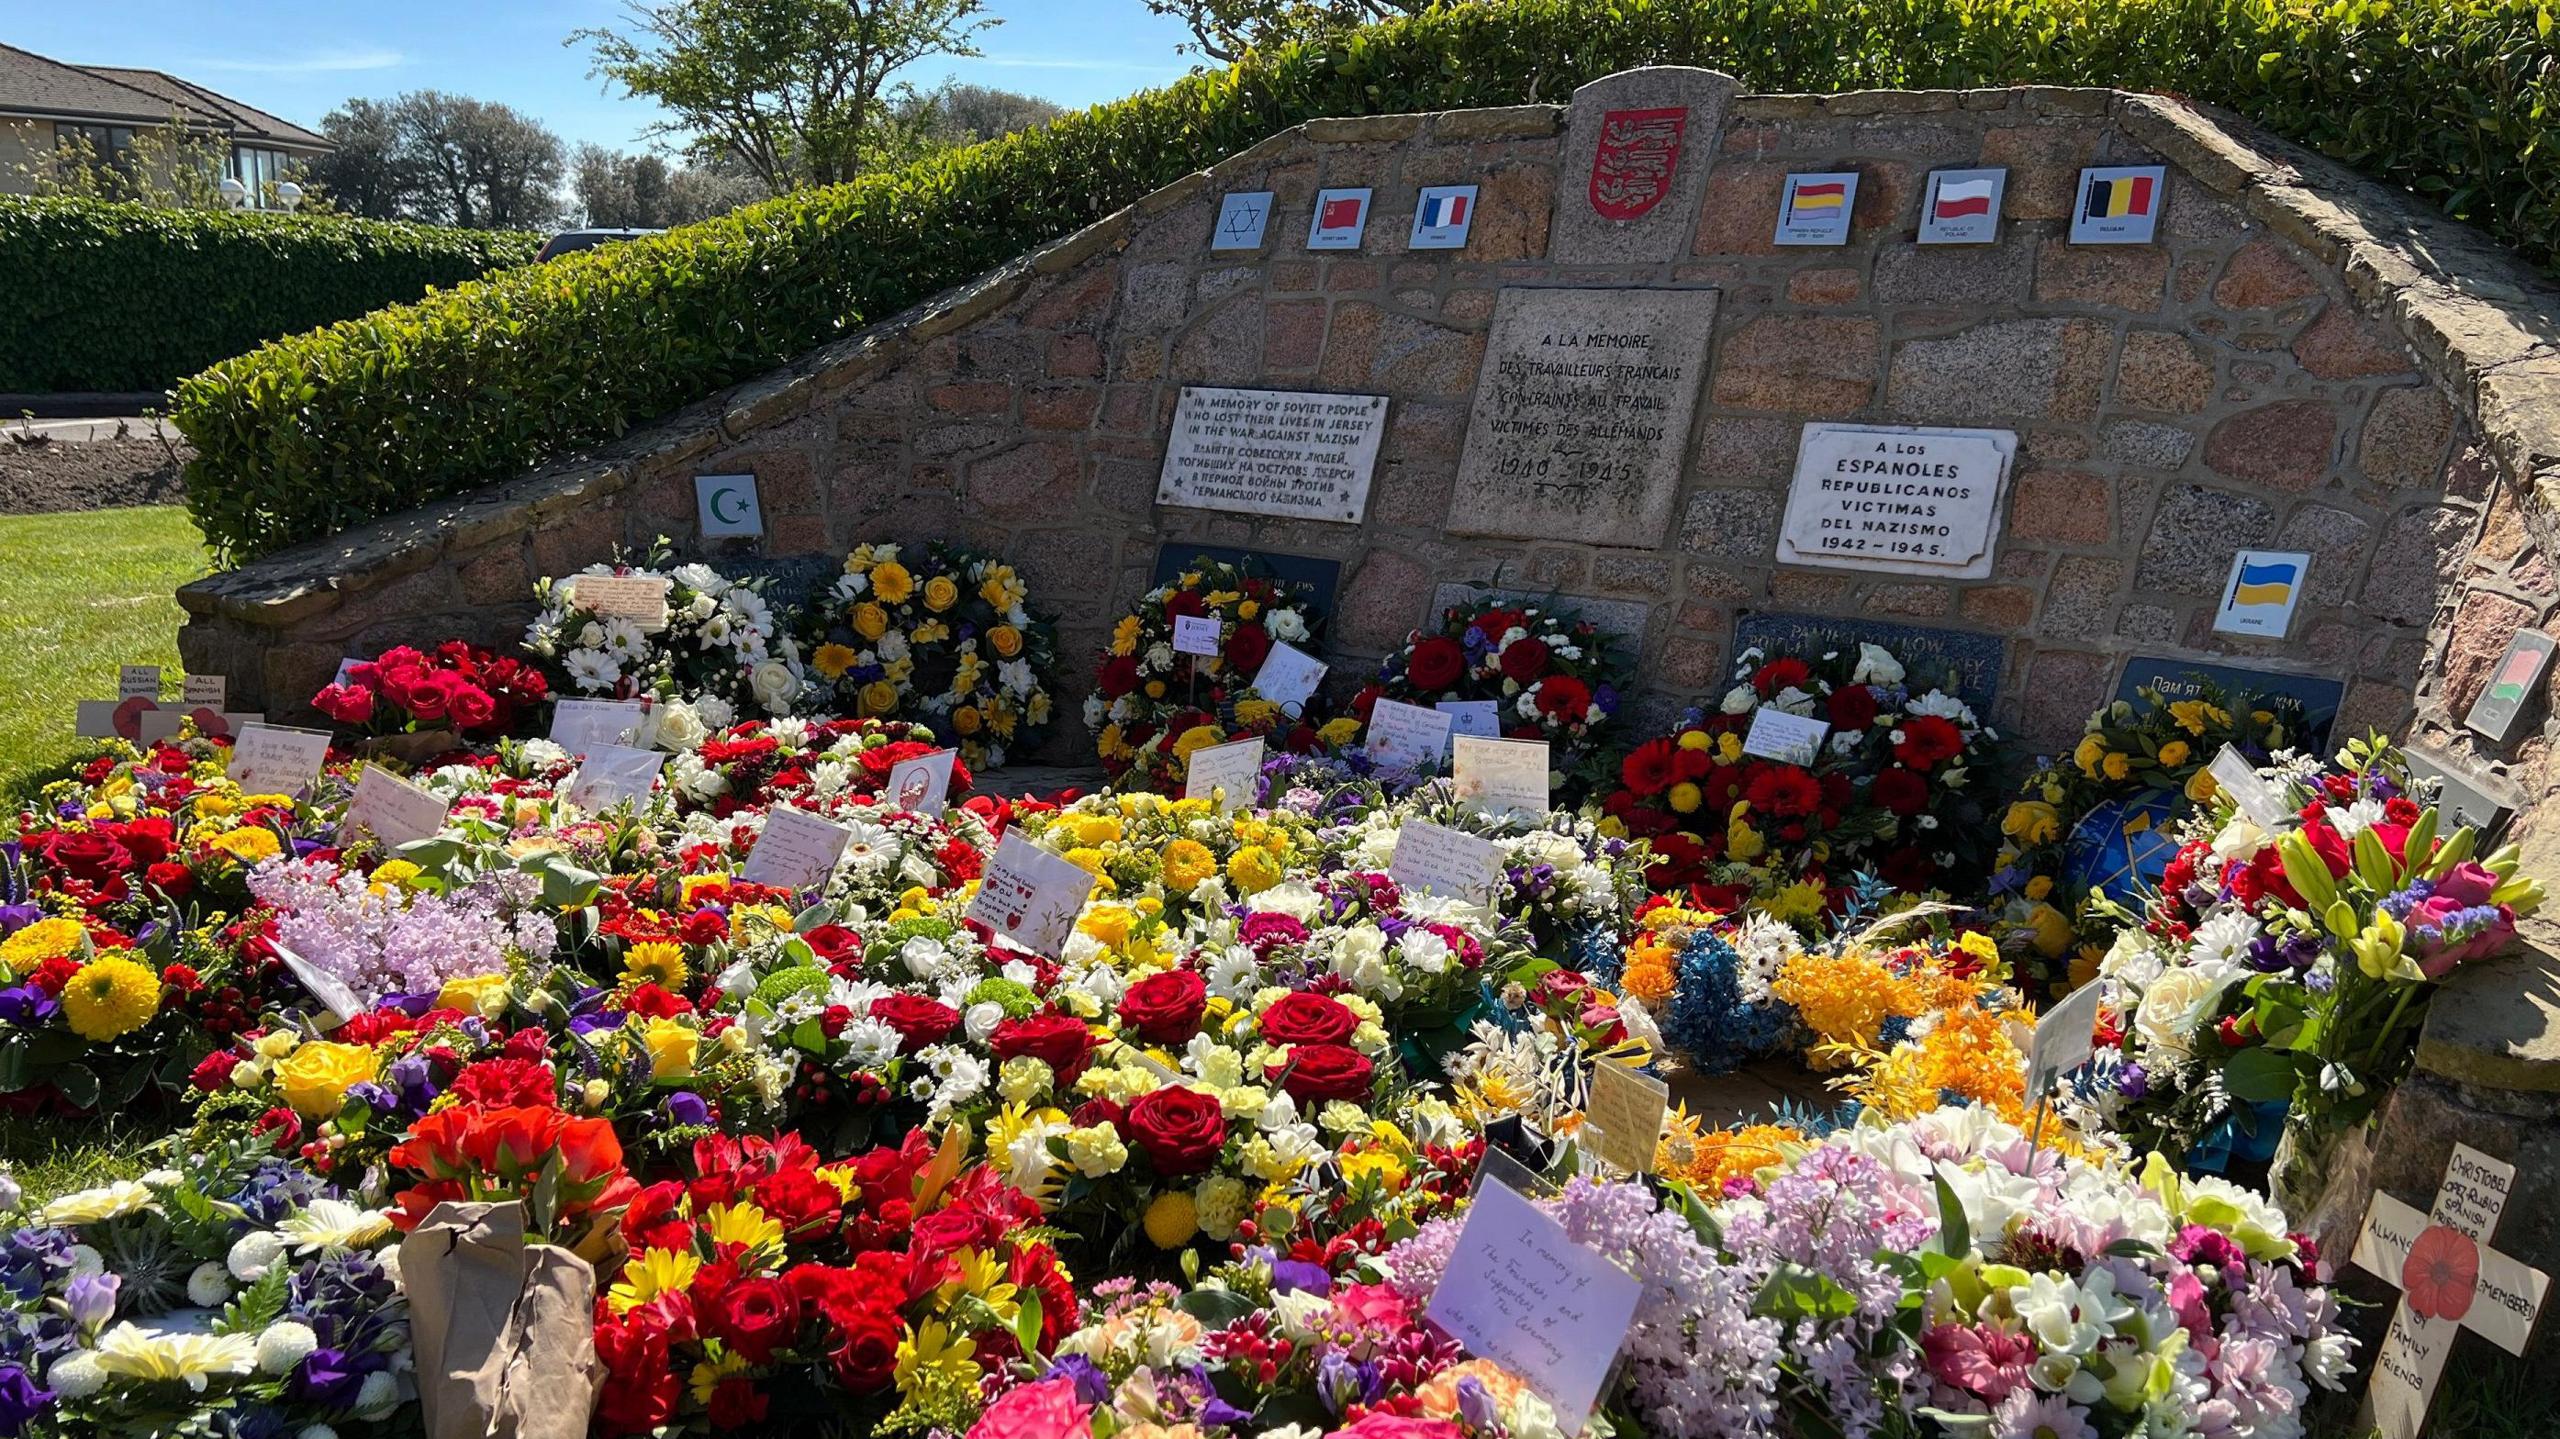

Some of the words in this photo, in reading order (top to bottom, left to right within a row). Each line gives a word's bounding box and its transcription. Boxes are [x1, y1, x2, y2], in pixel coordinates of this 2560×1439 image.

[1541, 334, 1552, 346] A
[1559, 334, 1578, 346] LA
[1586, 334, 1650, 349] MEMOIRE
[1498, 361, 1522, 376] DES
[1528, 361, 1613, 378] TRAVAILLEURS
[1193, 398, 1205, 408] IN
[1209, 398, 1261, 411] MEMORY
[1265, 401, 1281, 411] OF
[1283, 402, 1323, 414] SOVIET
[1326, 405, 1368, 416] PEOPLE
[1500, 391, 1581, 409] CONTRAINTS
[1587, 395, 1607, 409] AU
[1616, 396, 1665, 411] TRAVAIL
[1185, 410, 1210, 421] WHO
[1214, 411, 1240, 423] LOST
[1244, 413, 1274, 426] THEIR
[1279, 415, 1310, 428] LIVES
[1312, 417, 1325, 429] IN
[1328, 418, 1374, 432] JERSEY
[1491, 420, 1549, 436] VICTIMES
[1556, 423, 1580, 437] DES
[1588, 425, 1665, 441] ALLEMANDS
[1188, 424, 1201, 435] IN
[1204, 425, 1224, 437] THE
[1229, 427, 1255, 438] WAR
[1259, 430, 1311, 443] AGAINST
[1315, 432, 1360, 446] NAZISM
[1238, 447, 1302, 461] СОВЕТСКИХ
[1875, 442, 1887, 453] A
[1192, 471, 1198, 482] В
[1200, 473, 1244, 486] ПЕРИОД
[1238, 461, 1253, 474] НА
[1257, 463, 1308, 478] ОСТРОВЕ
[1500, 458, 1549, 477] 1940
[1579, 463, 1633, 482] 1945
[1192, 486, 1267, 503] ГЕРМАНСКОГО
[1821, 479, 1971, 499] REPUBLICANOS
[1841, 500, 1937, 517] VICTIMAS
[1821, 518, 1852, 530] DEL
[1862, 520, 1950, 537] NAZISMO
[1822, 537, 1865, 550] 1942
[121, 676, 156, 684] RUSSIAN
[194, 677, 216, 685] ALL
[2450, 1154, 2509, 1196] CHRISTOBEL
[2445, 1197, 2487, 1229] SPANISH
[2368, 1217, 2413, 1254] ALWAYS
[1517, 1228, 1533, 1250] In
[1536, 1247, 1574, 1287] memory
[1575, 1273, 1592, 1294] of
[1481, 1243, 1500, 1264] The
[1504, 1257, 1549, 1302] Founders
[1557, 1304, 1583, 1323] and
[1482, 1269, 1535, 1313] Supporters
[1543, 1316, 1558, 1329] of
[1445, 1305, 1465, 1323] who
[1467, 1323, 1482, 1338] are
[1493, 1295, 1510, 1317] The
[1514, 1315, 1567, 1367] Ceremony
[2390, 1322, 2430, 1360] FAMILY
